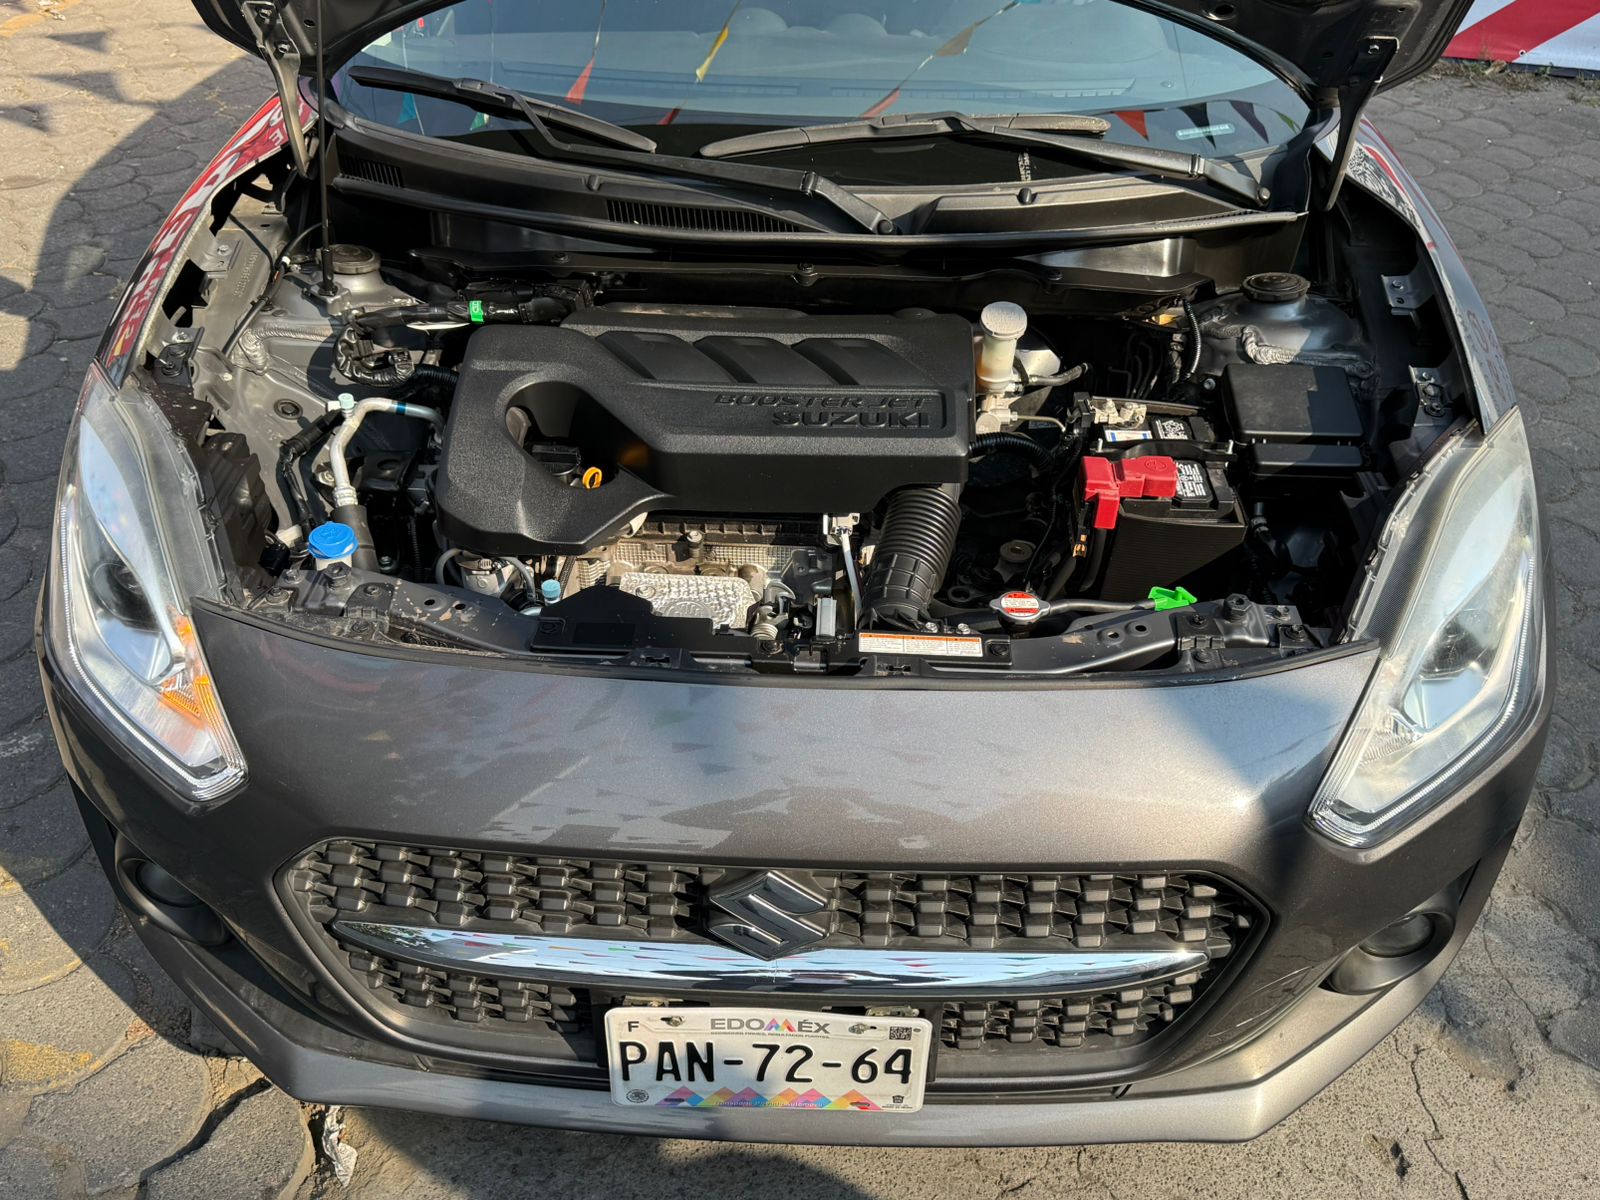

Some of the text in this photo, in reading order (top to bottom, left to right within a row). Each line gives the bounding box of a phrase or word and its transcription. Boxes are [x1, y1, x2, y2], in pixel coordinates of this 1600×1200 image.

[772, 411, 931, 429] SUZUKI
[627, 1020, 640, 1033] F
[710, 1018, 831, 1035] EDOMÉX
[618, 1040, 913, 1085] PAN-72-64
